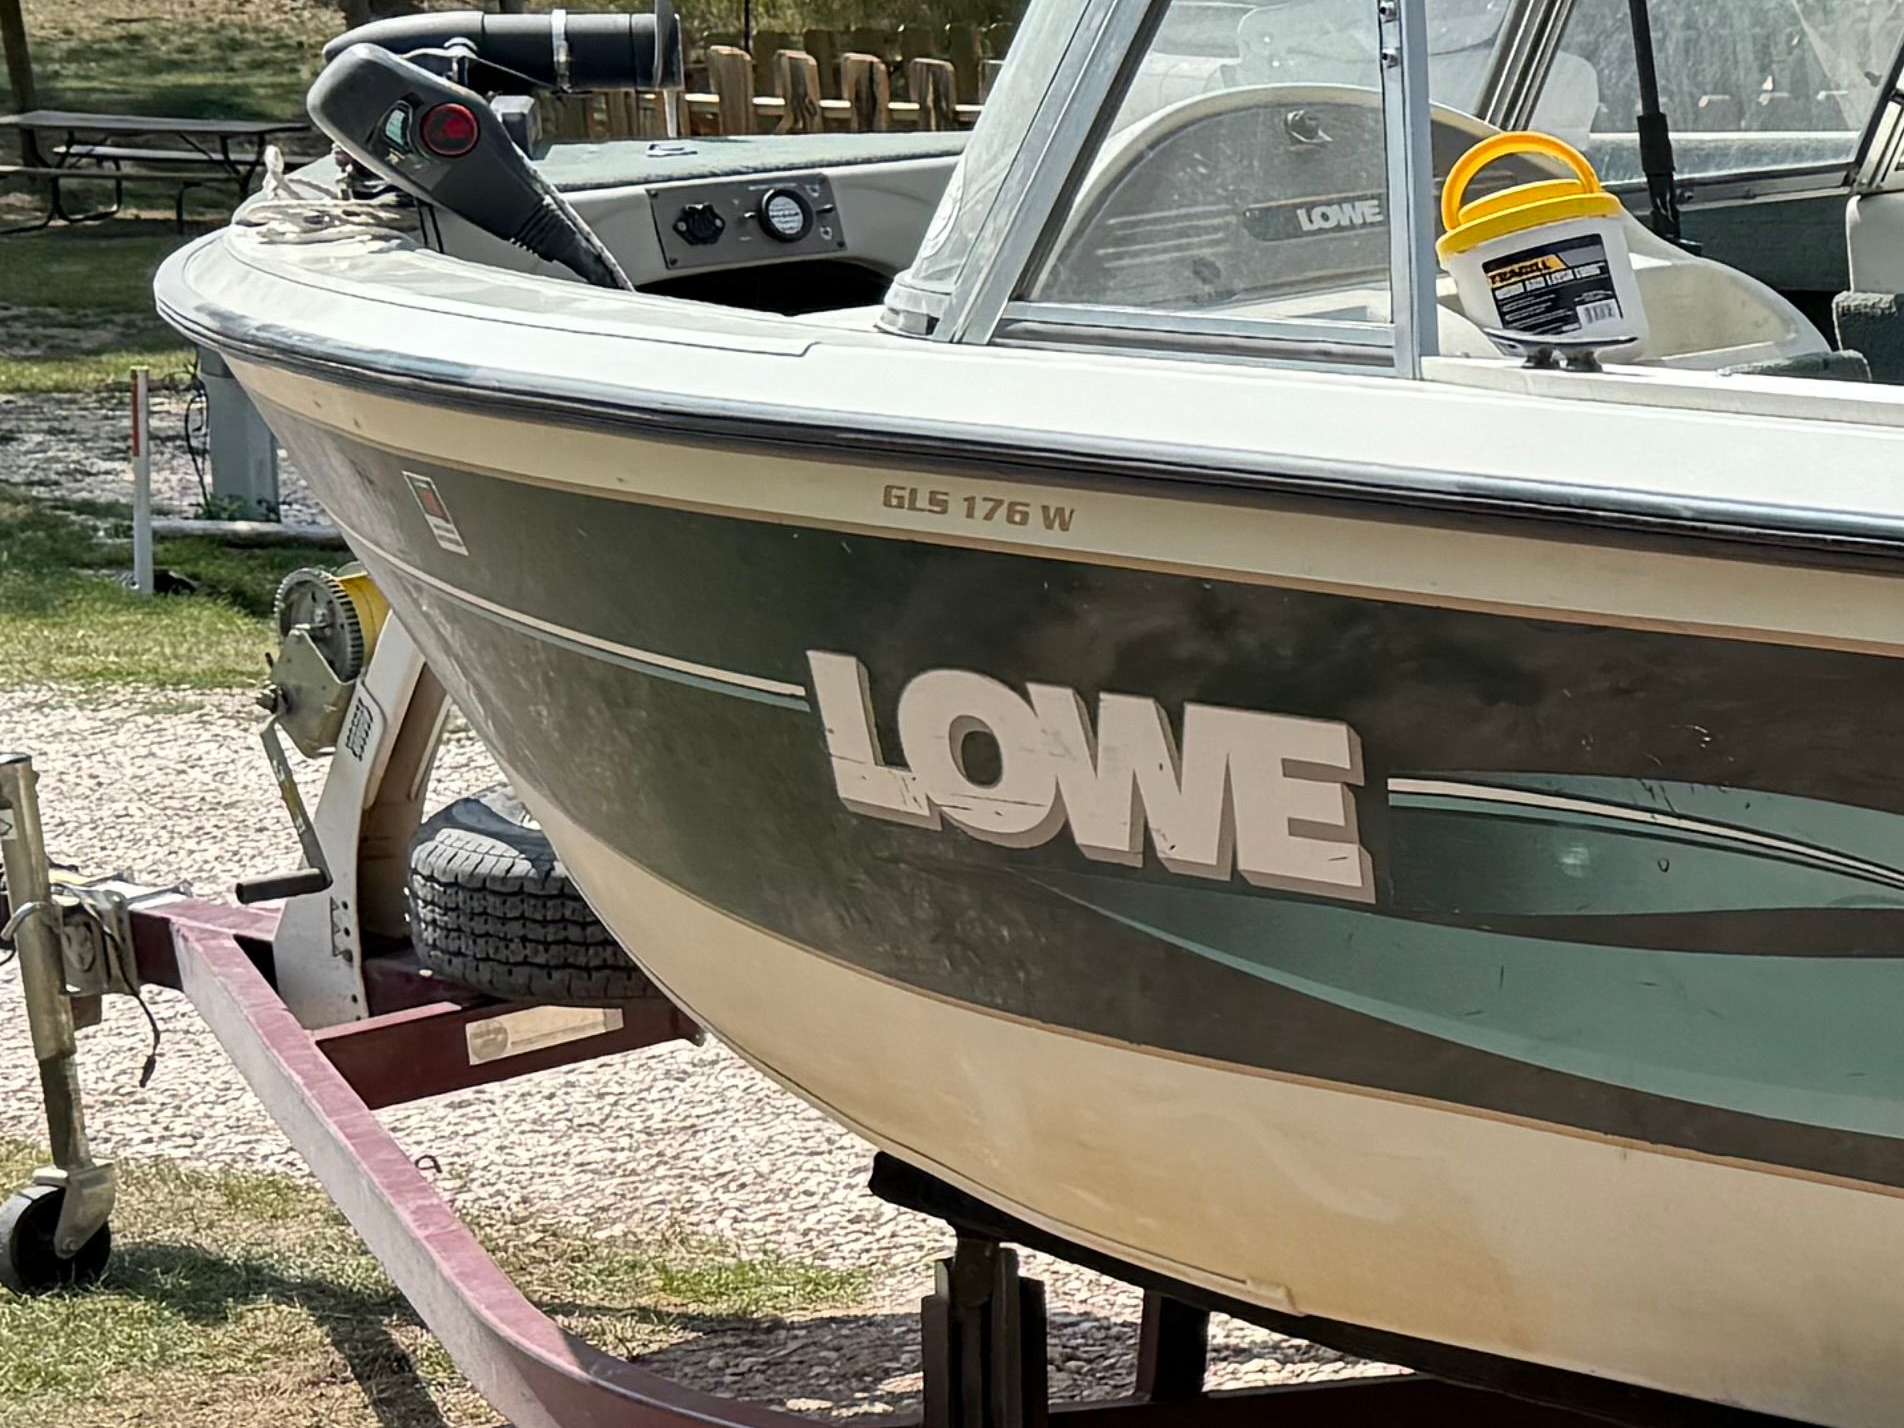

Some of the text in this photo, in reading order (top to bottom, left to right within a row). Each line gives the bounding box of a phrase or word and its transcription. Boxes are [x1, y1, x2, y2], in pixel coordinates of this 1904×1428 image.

[1296, 198, 1385, 232] LOWE
[882, 483, 1077, 533] GLS 176 W
[805, 648, 1377, 905] LOWE
